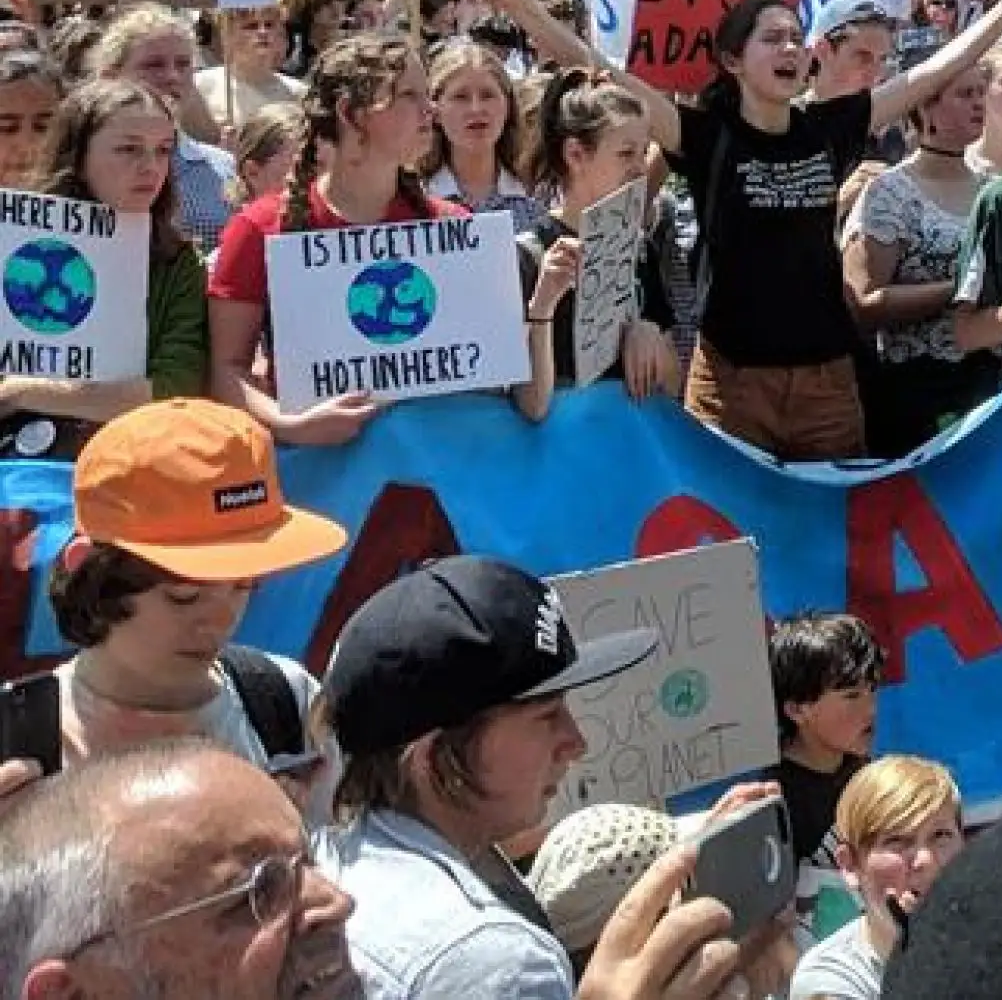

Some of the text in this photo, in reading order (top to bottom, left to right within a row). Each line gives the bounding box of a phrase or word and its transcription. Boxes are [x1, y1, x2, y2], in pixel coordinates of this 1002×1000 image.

[61, 201, 86, 233] IS
[88, 203, 117, 238] NO
[302, 216, 481, 270] IS IT GETTING
[66, 345, 95, 380] B!
[312, 343, 482, 397] HOT IN HERE?
[608, 722, 742, 803] PLANET
